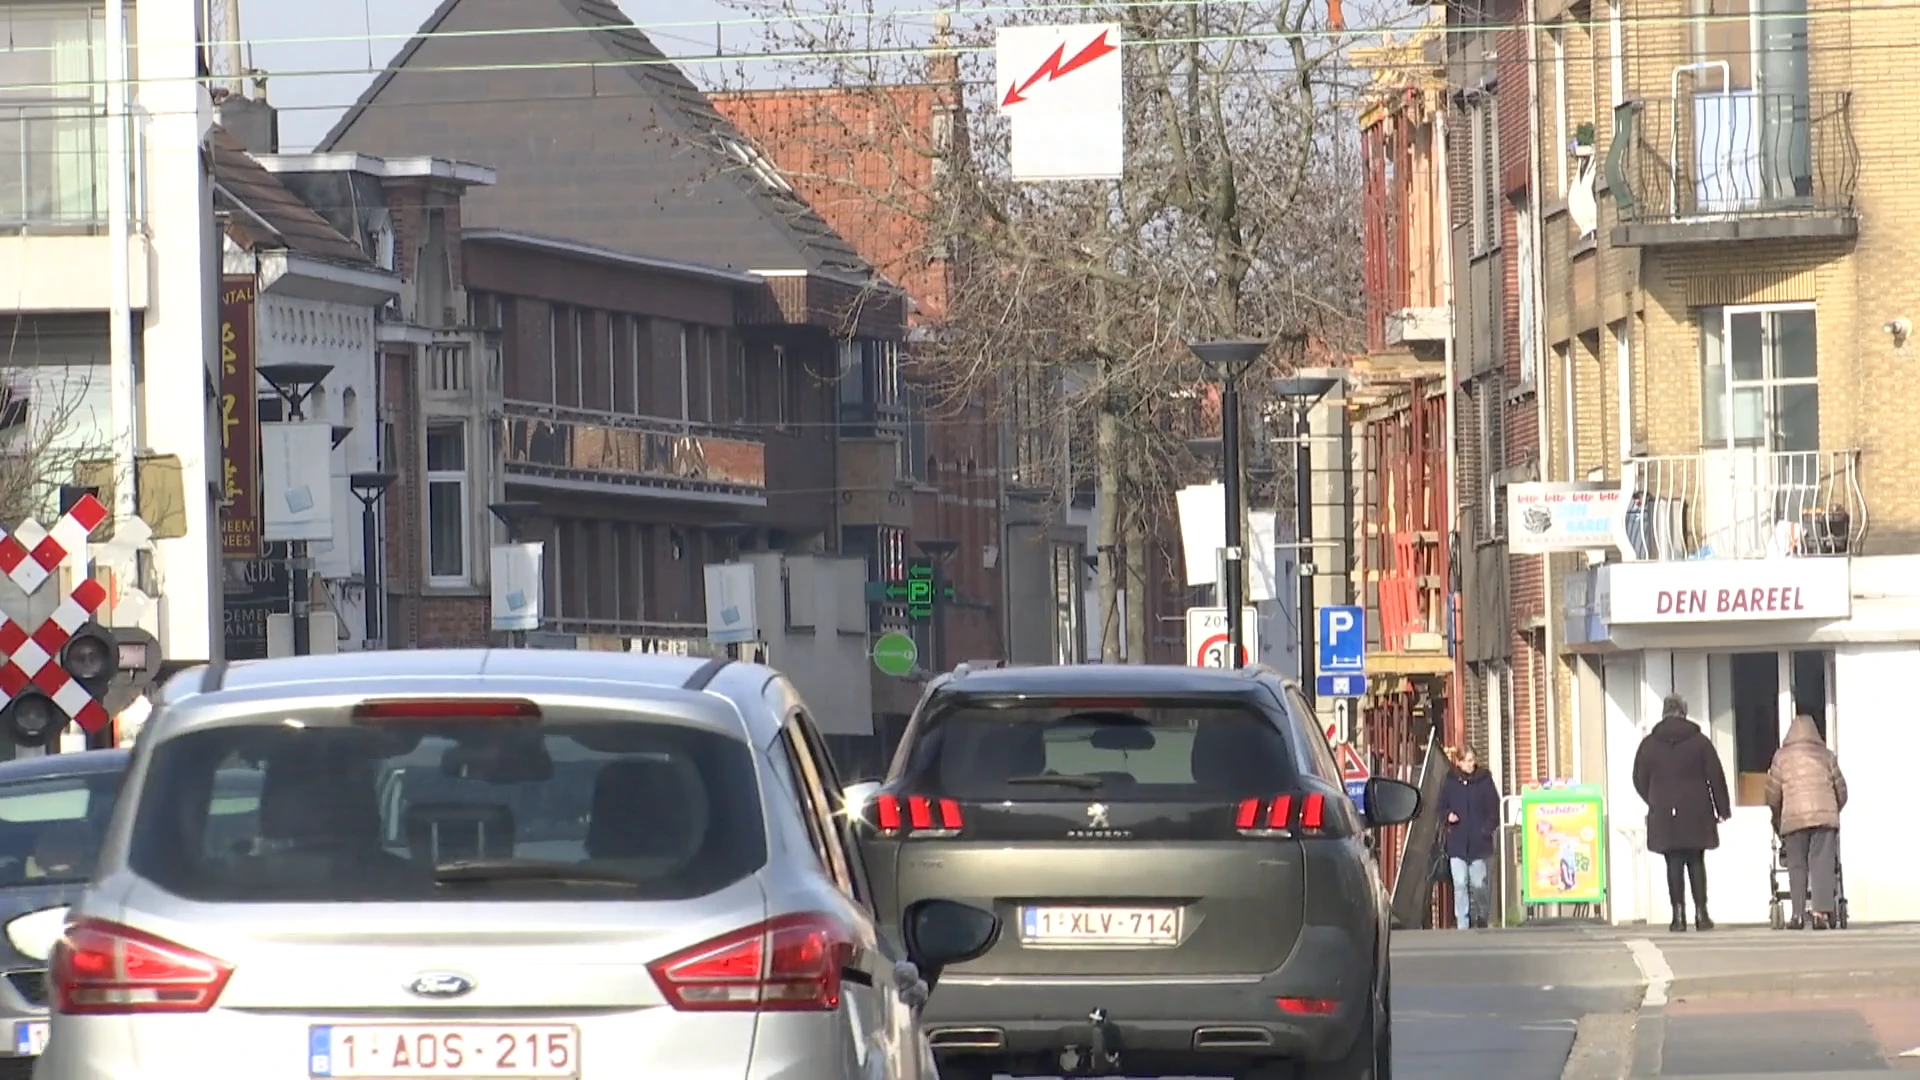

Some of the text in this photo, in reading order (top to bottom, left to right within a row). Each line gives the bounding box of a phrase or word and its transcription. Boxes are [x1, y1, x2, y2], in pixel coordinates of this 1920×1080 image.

[911, 582, 929, 600] P
[1656, 586, 1805, 614] DEN BAREEL
[1329, 611, 1354, 646] P
[1042, 912, 1173, 935] 1-XLV-714
[342, 1032, 569, 1070] 1-AOS-215
